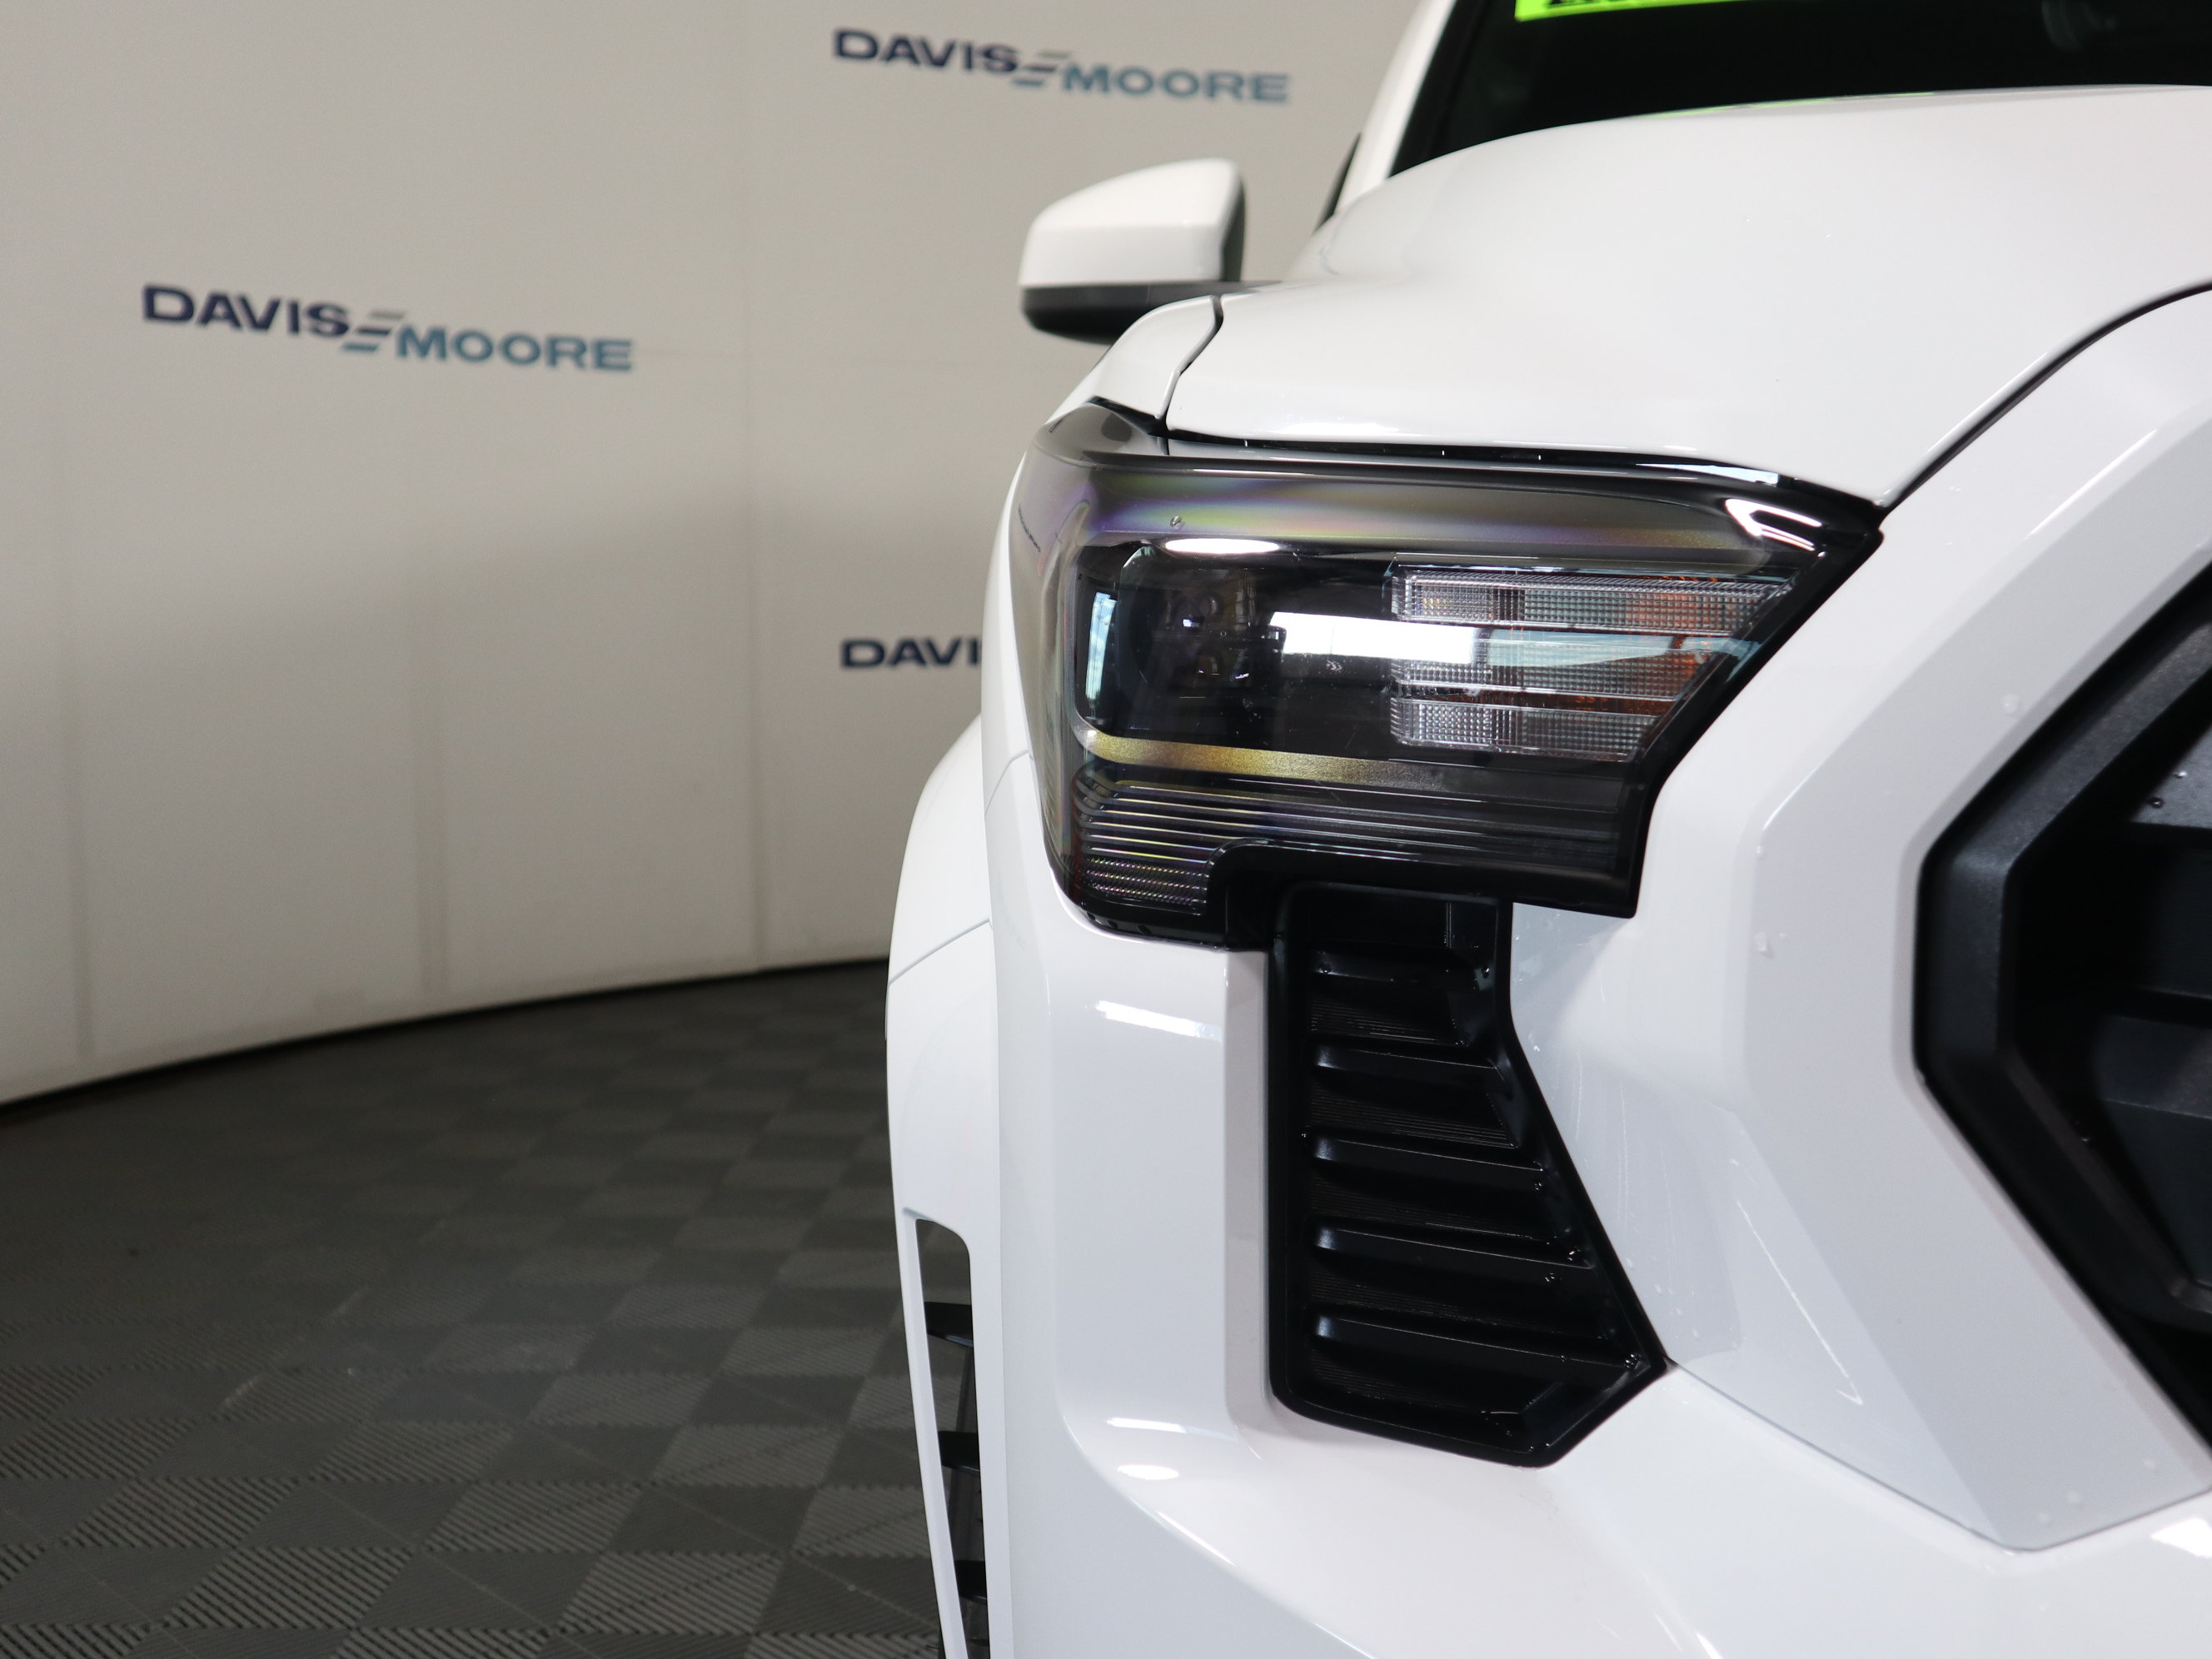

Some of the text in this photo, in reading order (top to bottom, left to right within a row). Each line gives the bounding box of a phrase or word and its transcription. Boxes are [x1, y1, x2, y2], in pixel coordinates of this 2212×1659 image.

[834, 28, 1289, 103] DAVIS MOORE
[142, 285, 633, 372] DAVIS MOORE
[841, 637, 981, 669] DAVI
